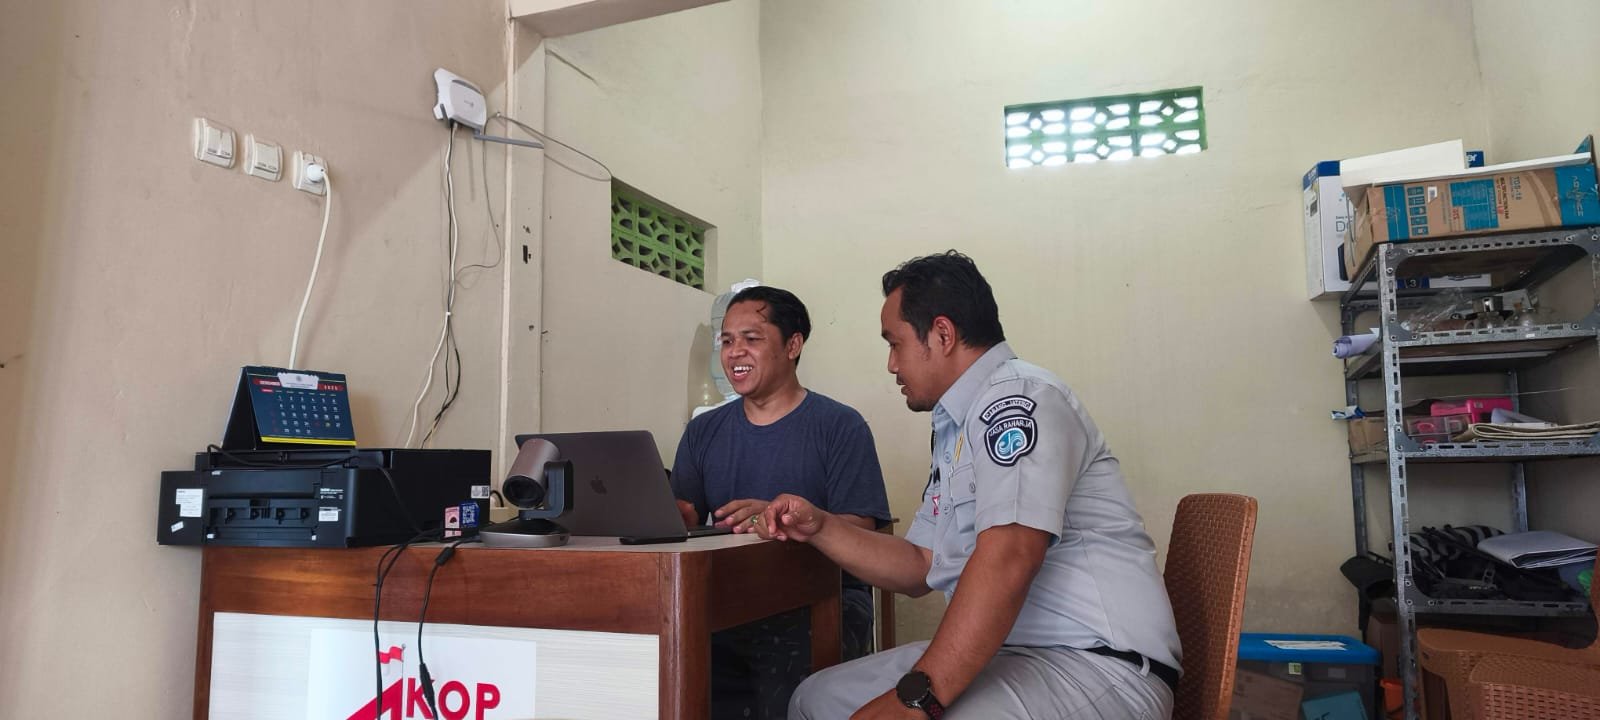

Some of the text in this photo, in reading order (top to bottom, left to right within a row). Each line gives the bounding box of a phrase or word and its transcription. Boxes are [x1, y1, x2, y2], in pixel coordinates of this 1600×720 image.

[1409, 279, 1417, 288] 3
[989, 419, 1032, 437] JASA RAHARJA
[407, 677, 500, 720] KOP
